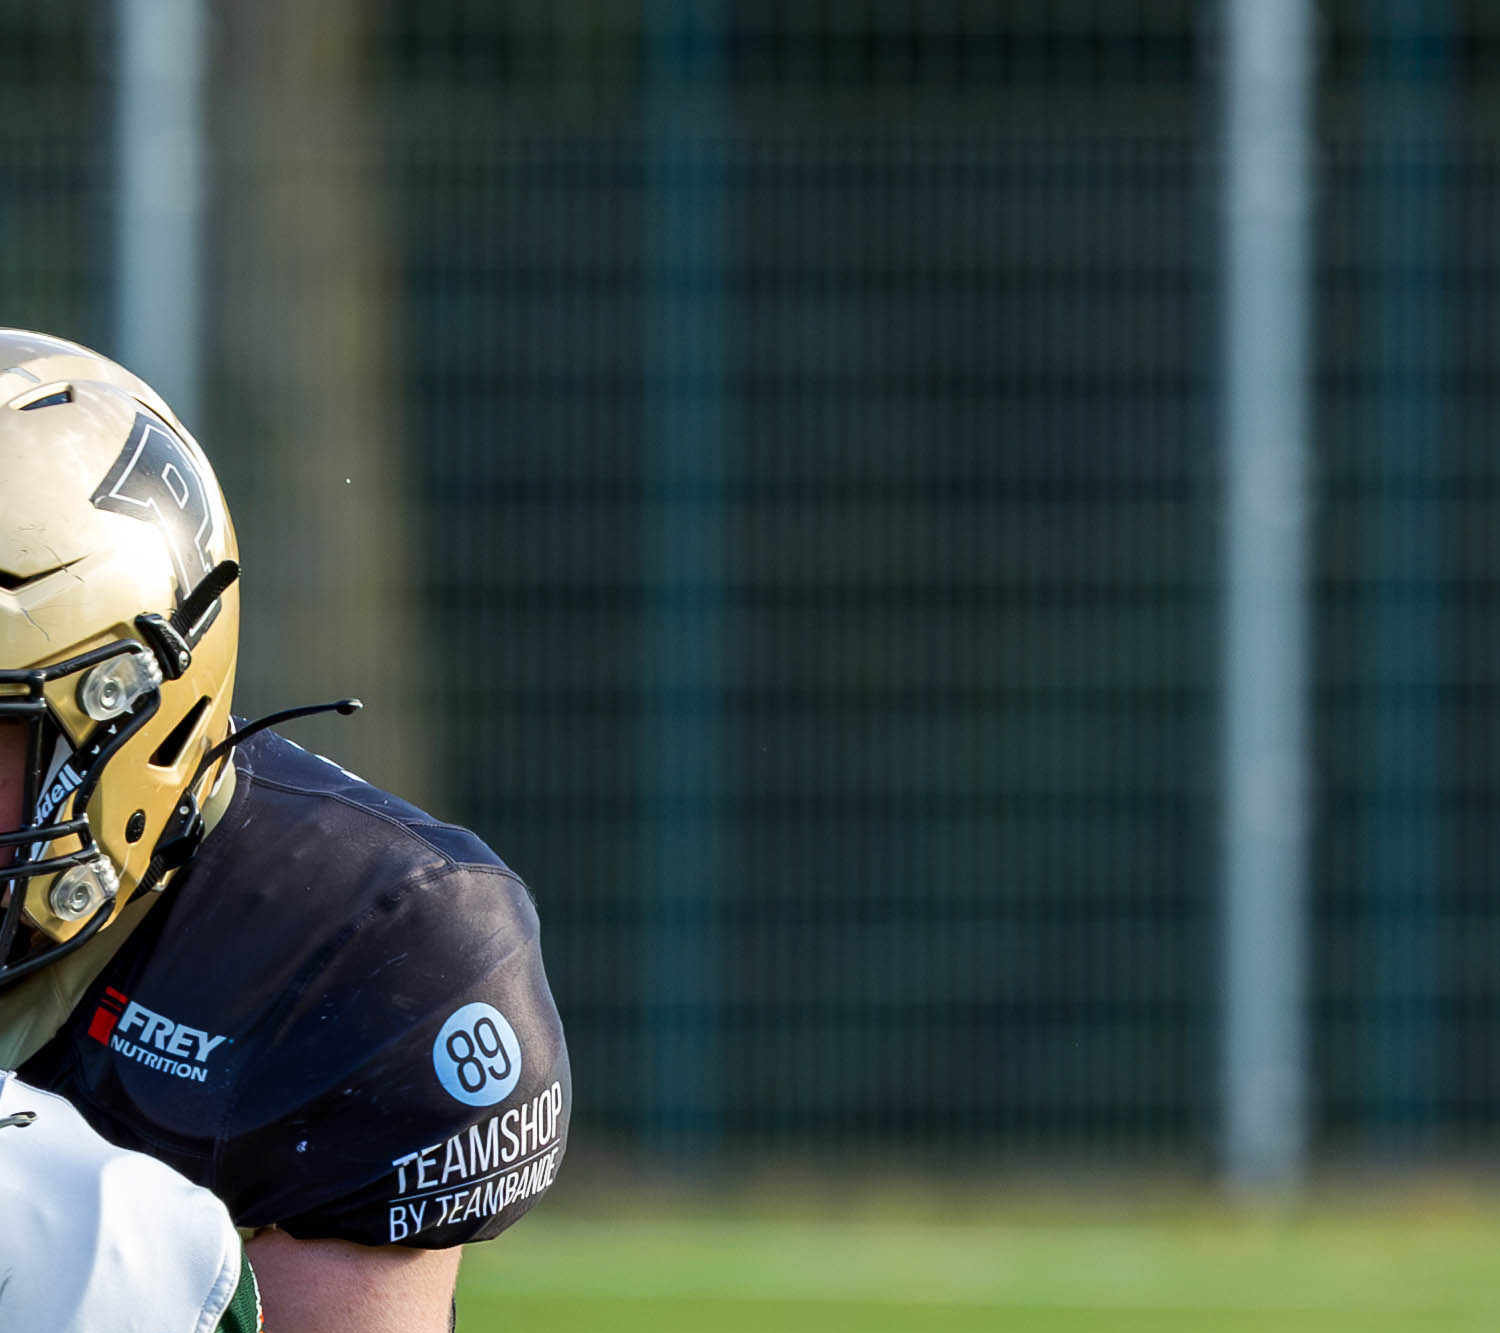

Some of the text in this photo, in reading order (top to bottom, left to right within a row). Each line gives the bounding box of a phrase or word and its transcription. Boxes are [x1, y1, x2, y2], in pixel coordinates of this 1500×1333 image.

[110, 1034, 208, 1083] NUTRITION
[117, 1000, 227, 1063] FREY
[446, 1016, 512, 1094] 89
[392, 1080, 562, 1194] TEAMSHOP
[389, 1146, 560, 1243] BY TEAMBANDE
